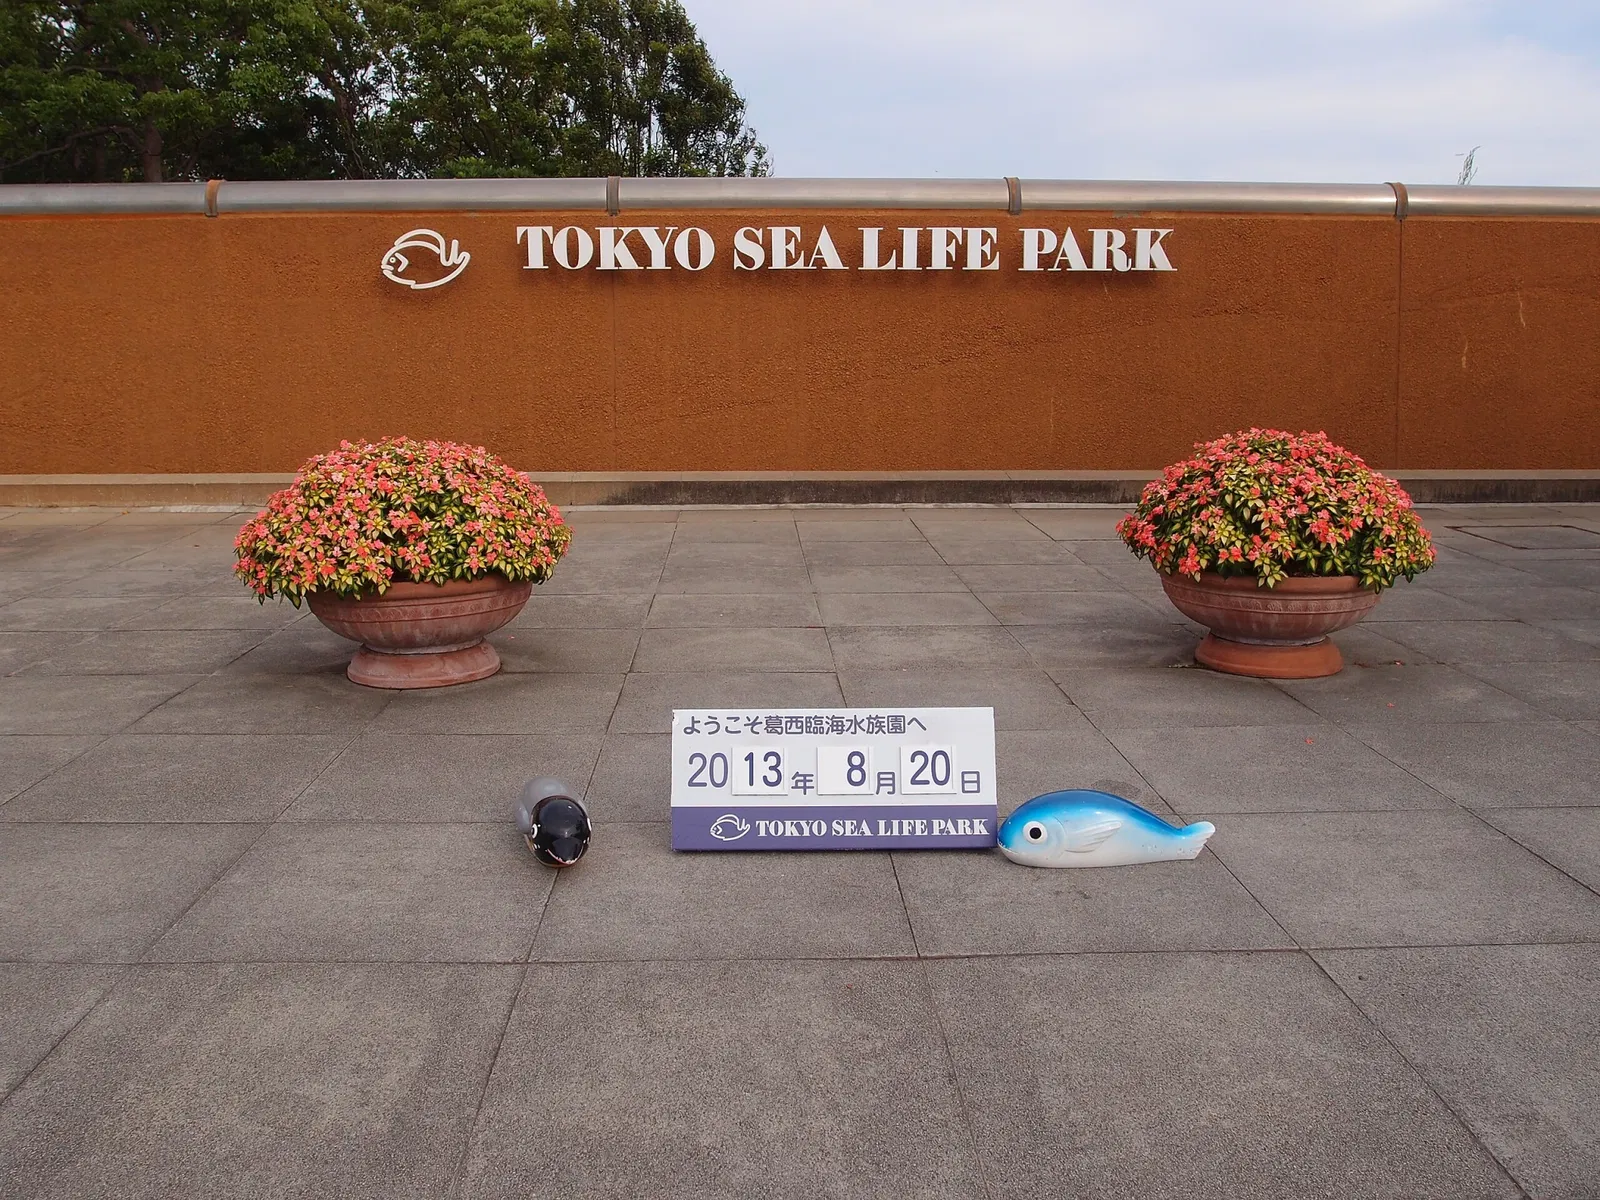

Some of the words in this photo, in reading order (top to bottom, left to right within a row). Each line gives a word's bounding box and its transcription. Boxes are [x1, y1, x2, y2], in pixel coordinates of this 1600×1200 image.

[516, 225, 716, 271] TOKYO
[733, 225, 849, 271] SEA
[857, 226, 1000, 271] LIFE
[1018, 226, 1178, 273] PARK
[683, 714, 927, 736] ようこそ葛西臨海水族園へ
[755, 819, 828, 838] TOKYO
[831, 819, 873, 837] SEA
[876, 818, 928, 836] LIFE
[931, 818, 990, 836] PARK
